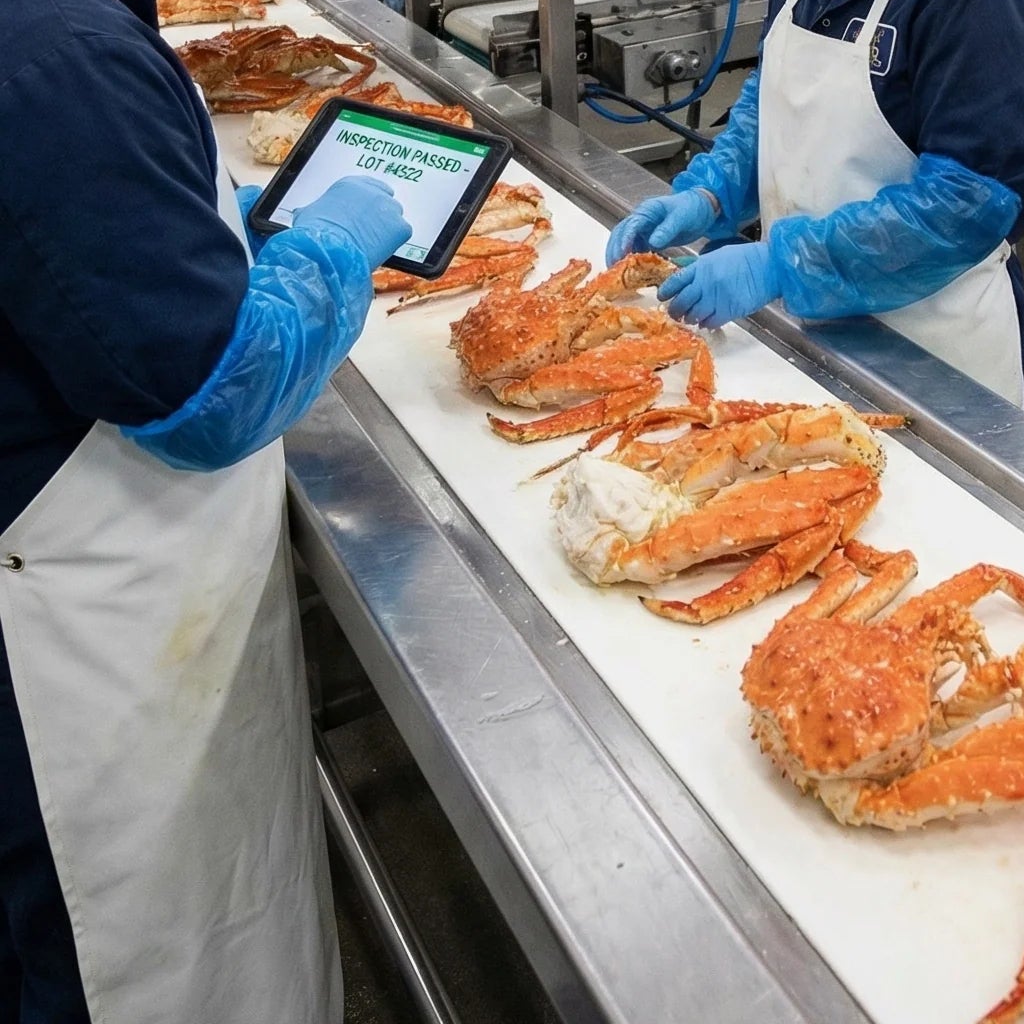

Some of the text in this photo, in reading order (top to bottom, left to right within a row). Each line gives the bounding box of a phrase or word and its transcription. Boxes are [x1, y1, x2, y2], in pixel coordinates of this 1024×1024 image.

[336, 128, 413, 160] INSPECTION
[410, 149, 462, 173] PASSED
[356, 153, 386, 172] LOT
